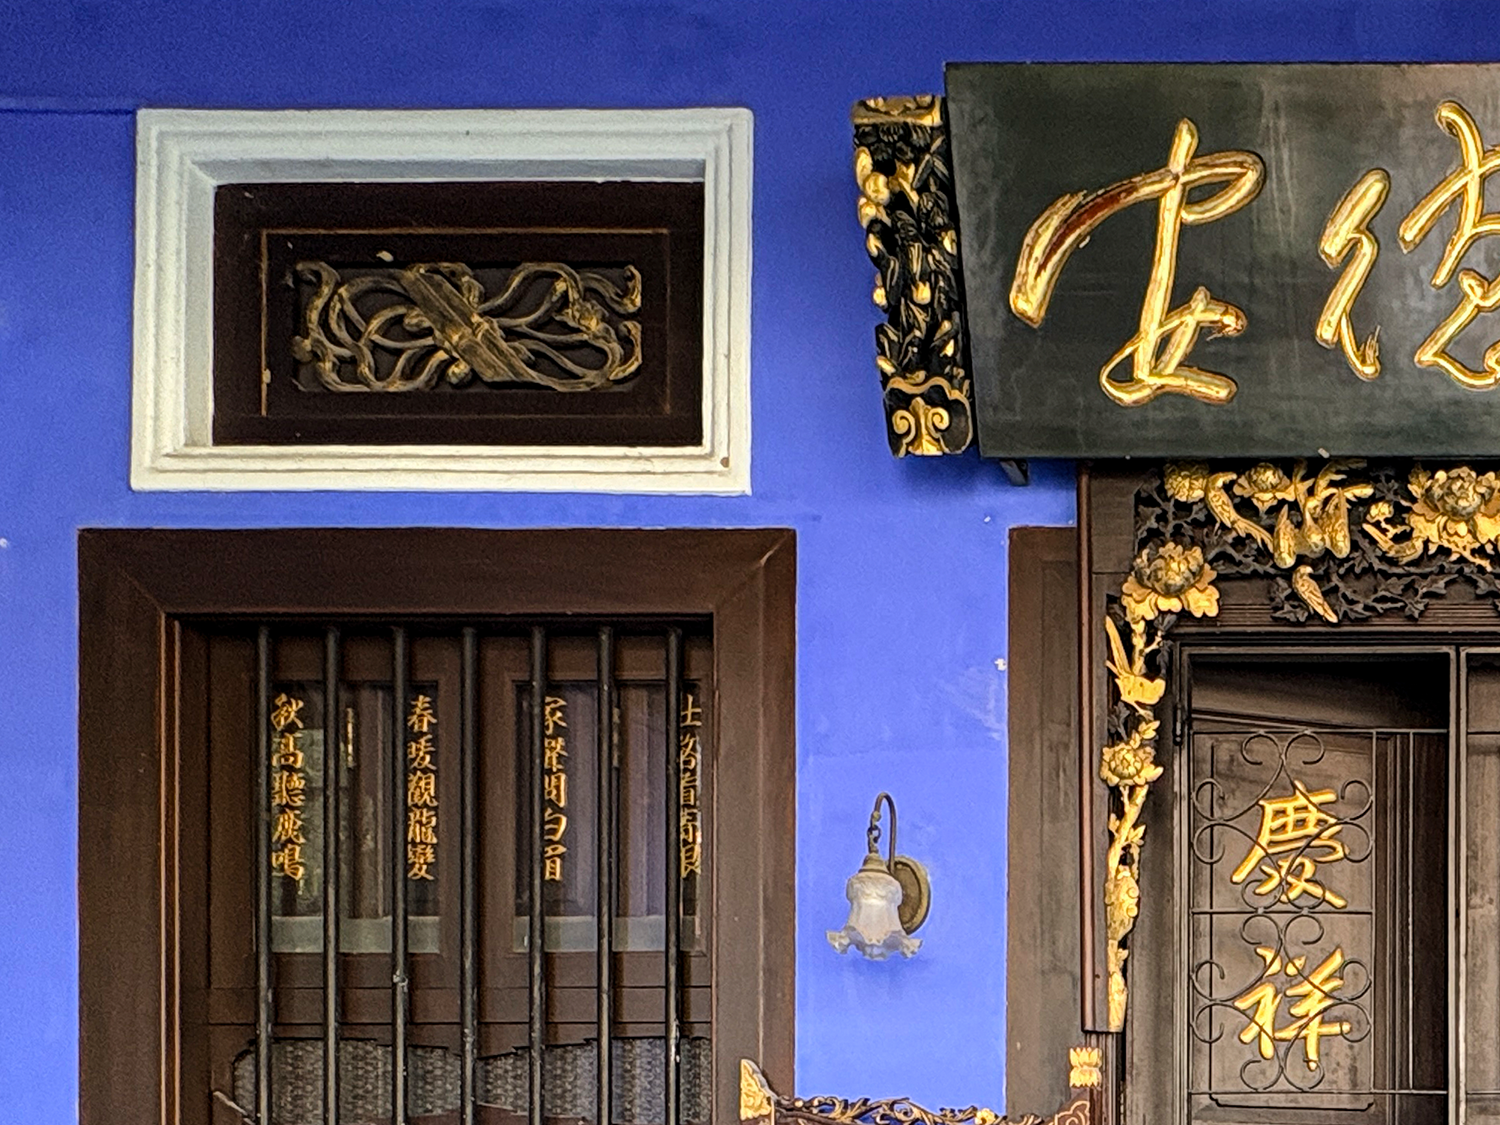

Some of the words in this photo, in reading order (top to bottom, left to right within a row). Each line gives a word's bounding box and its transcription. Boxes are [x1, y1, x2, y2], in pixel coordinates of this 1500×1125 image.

[406, 694, 438, 881] 春暖觀龍變
[1230, 780, 1352, 1071] 慶祥
